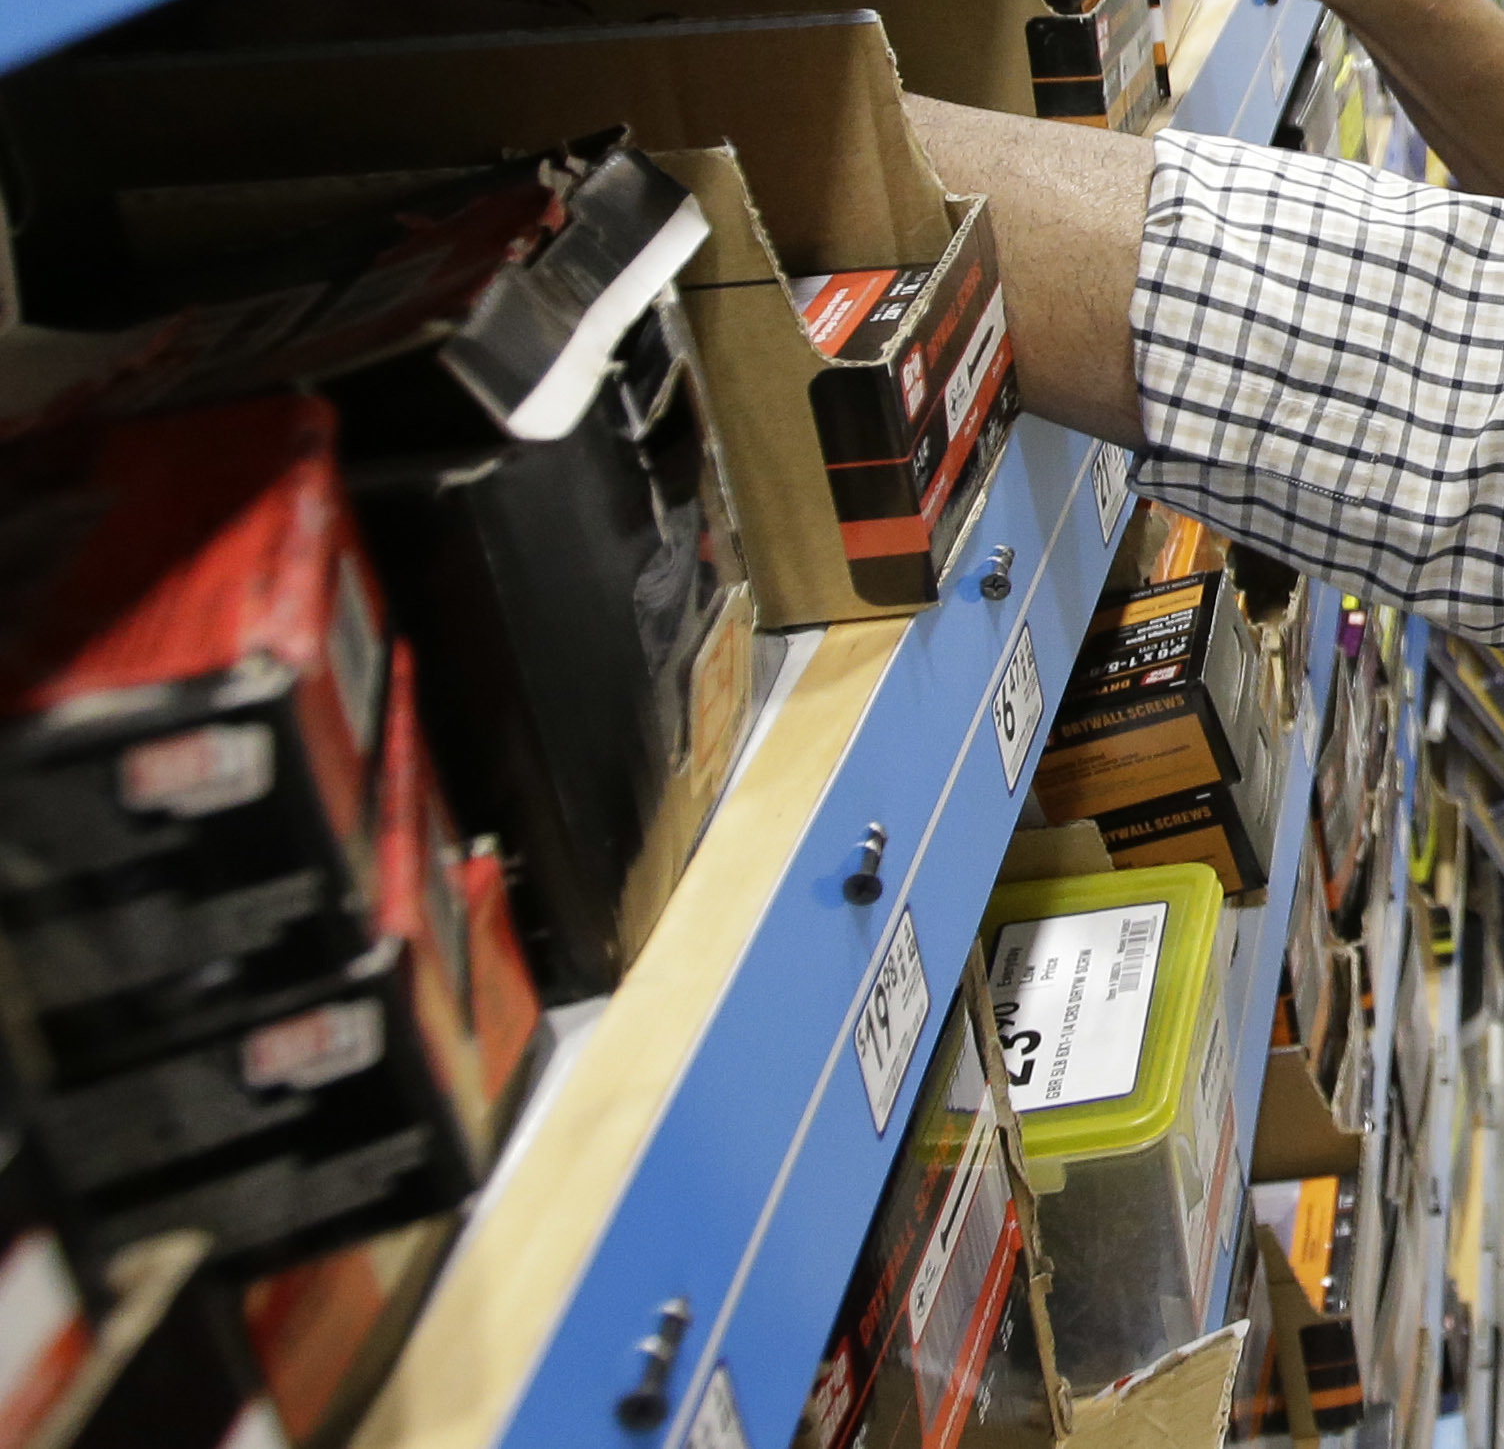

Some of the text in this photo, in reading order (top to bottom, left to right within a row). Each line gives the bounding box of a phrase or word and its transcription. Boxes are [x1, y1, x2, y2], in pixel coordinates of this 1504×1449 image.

[1062, 694, 1186, 738] DRYWALL SCREWS
[1155, 806, 1213, 833] SCREWS
[998, 945, 1021, 989] Everyday
[1021, 963, 1036, 984] Low
[1041, 955, 1059, 982] Price
